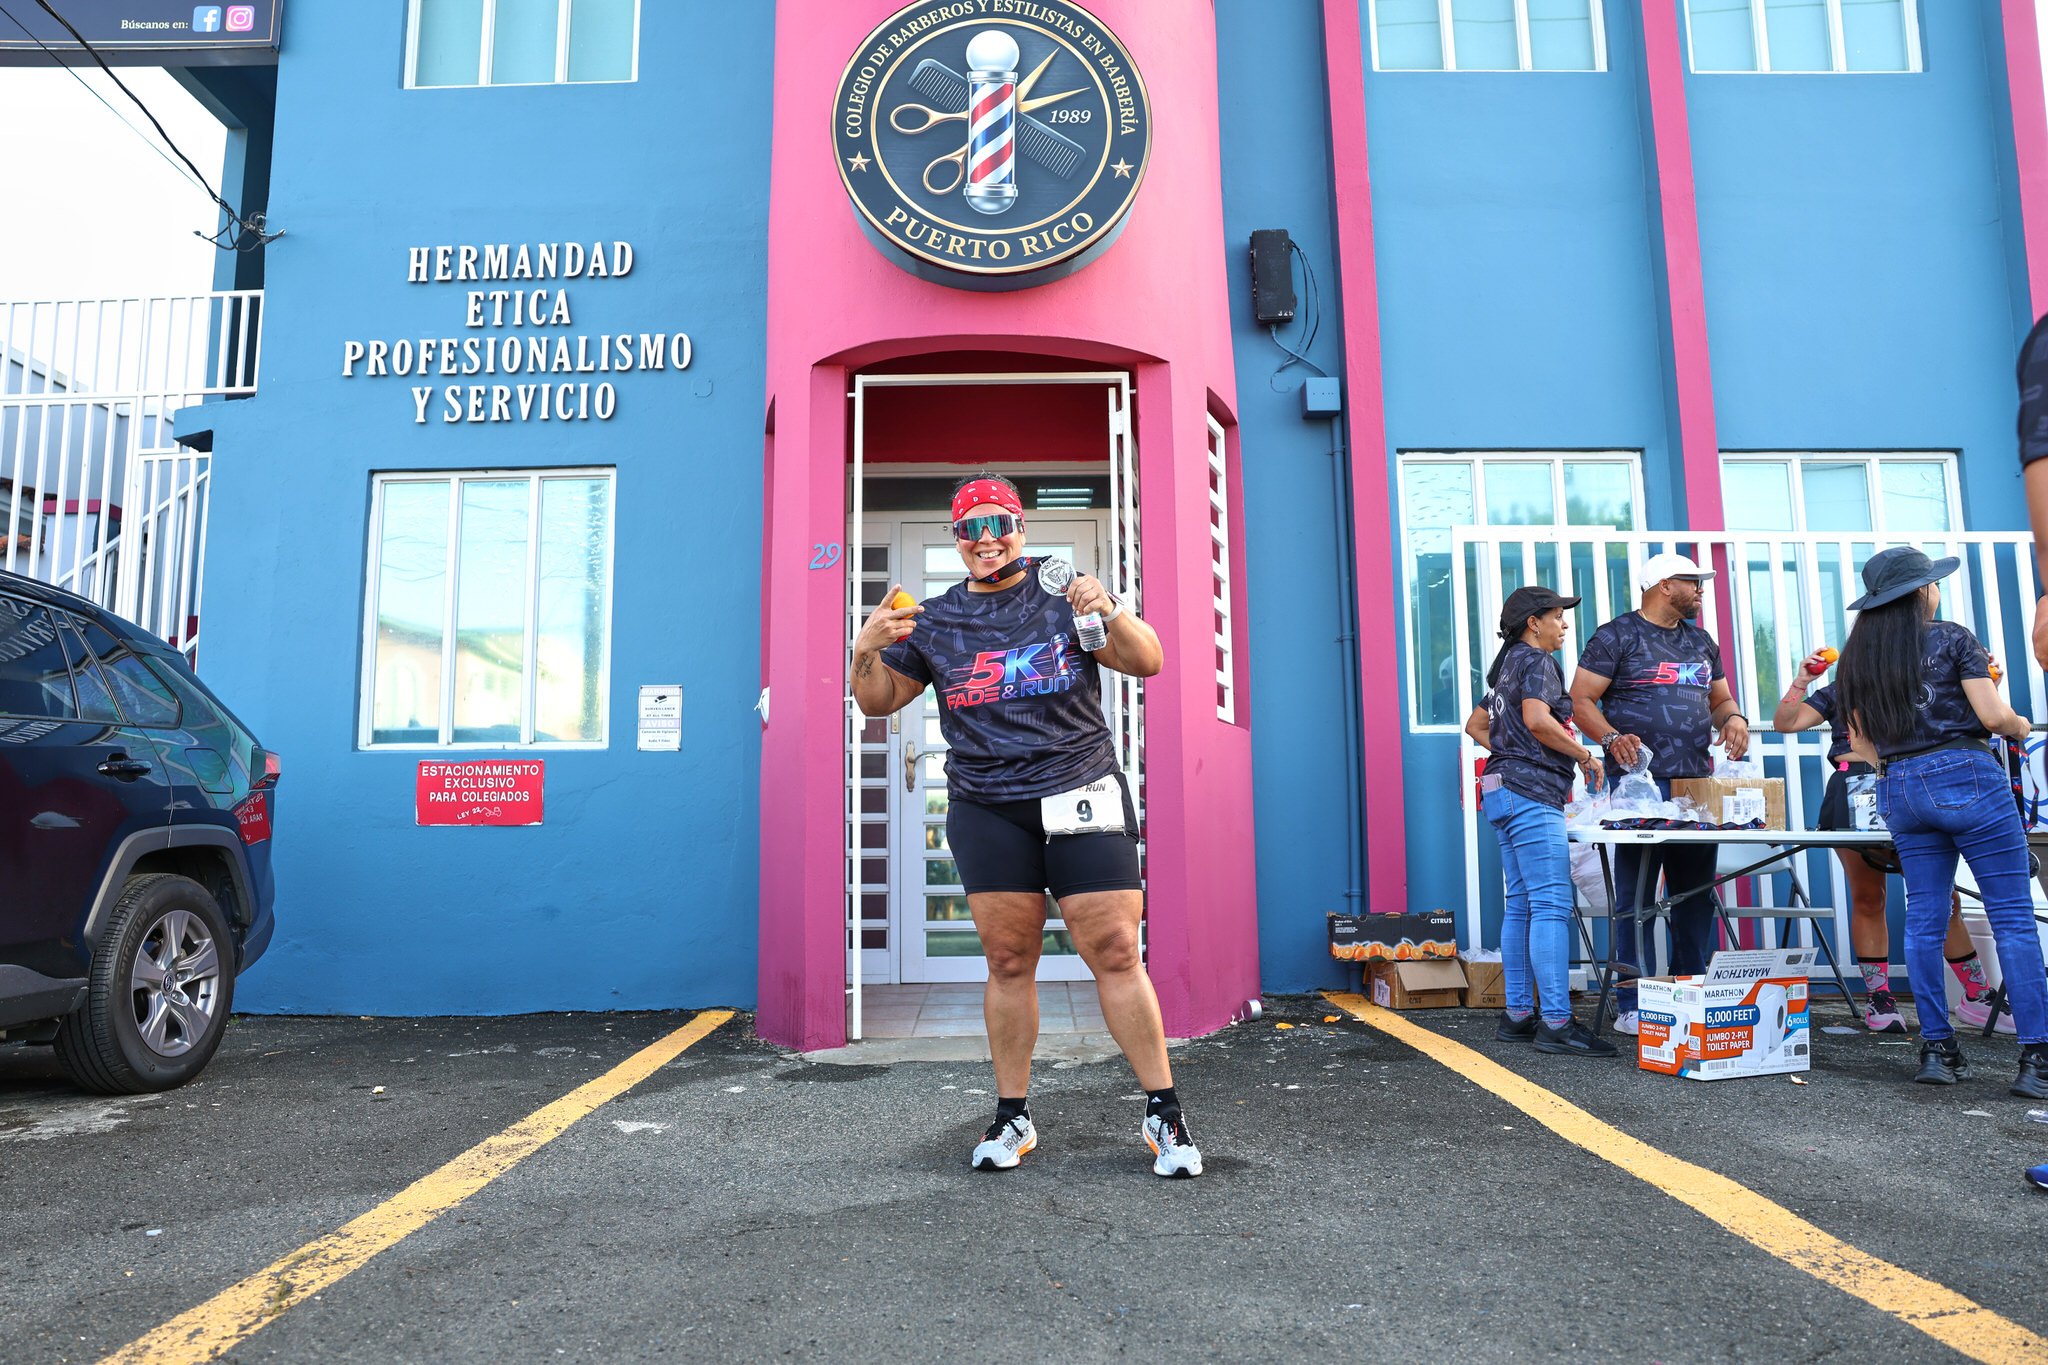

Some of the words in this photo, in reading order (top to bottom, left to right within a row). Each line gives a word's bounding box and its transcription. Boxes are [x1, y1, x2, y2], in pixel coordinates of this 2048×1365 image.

[121, 19, 170, 29] Búscanos
[172, 20, 189, 29] en:
[846, 66, 876, 138] COLEGIO
[869, 43, 894, 67] DE
[887, 1, 974, 48] BARBEROS
[976, 0, 989, 12] Y
[993, 0, 1085, 39] ESTILISTAS
[1081, 32, 1107, 56] EN
[1098, 53, 1139, 136] BARBERÍA
[1049, 109, 1092, 124] 1989
[883, 205, 1011, 260] PUERTO
[1018, 211, 1094, 257] RICO
[407, 241, 634, 282] HERMANDAD
[465, 288, 571, 327] ETICA
[342, 332, 692, 376] PROFESIONALISMO
[411, 386, 432, 423] Y
[443, 382, 616, 422] SERVICIO
[808, 543, 842, 570] 29
[963, 643, 1050, 689] 5K
[1653, 661, 1703, 685] 5K
[946, 685, 1000, 711] FADE
[1001, 684, 1018, 699] &
[1020, 675, 1070, 697] RUN
[421, 764, 540, 776] ESTACIONAMIENTO
[444, 777, 515, 788] EXCLUSIVO
[1085, 783, 1106, 793] RUN
[429, 791, 457, 802] PARA
[461, 791, 530, 802] COLEGIADOS
[456, 810, 470, 820] LEY
[471, 806, 481, 814] 22
[1076, 799, 1093, 822] 9
[1713, 967, 1771, 980] MARATHON
[1640, 983, 1672, 993] MARATHON
[1704, 988, 1745, 999] MARATHON
[1641, 1011, 1657, 1021] 6,000
[1706, 1010, 1732, 1025] 6,000
[1787, 1015, 1793, 1027] 6
[1793, 1016, 1808, 1024] ROLLS
[1641, 1023, 1656, 1031] JUMBO
[1706, 1032, 1731, 1042] JUMBO
[1731, 1030, 1749, 1040] 2-PLY
[1706, 1041, 1729, 1051] TOILET
[1729, 1039, 1751, 1049] PAPER
